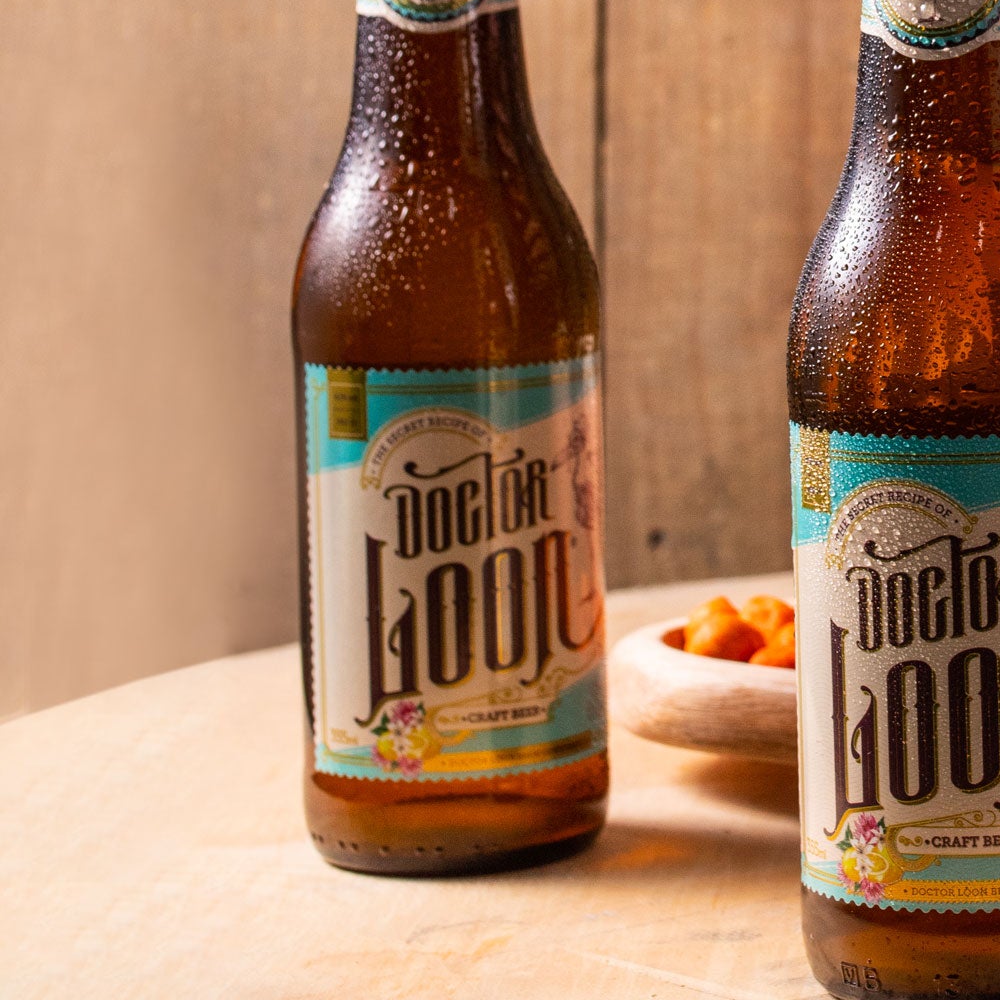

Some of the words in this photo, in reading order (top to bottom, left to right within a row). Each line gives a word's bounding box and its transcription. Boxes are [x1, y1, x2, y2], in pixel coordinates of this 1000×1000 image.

[887, 491, 933, 509] RECIPE
[934, 503, 953, 518] OF
[931, 836, 980, 849] CRAFT
[911, 887, 955, 897] DOCTOR
